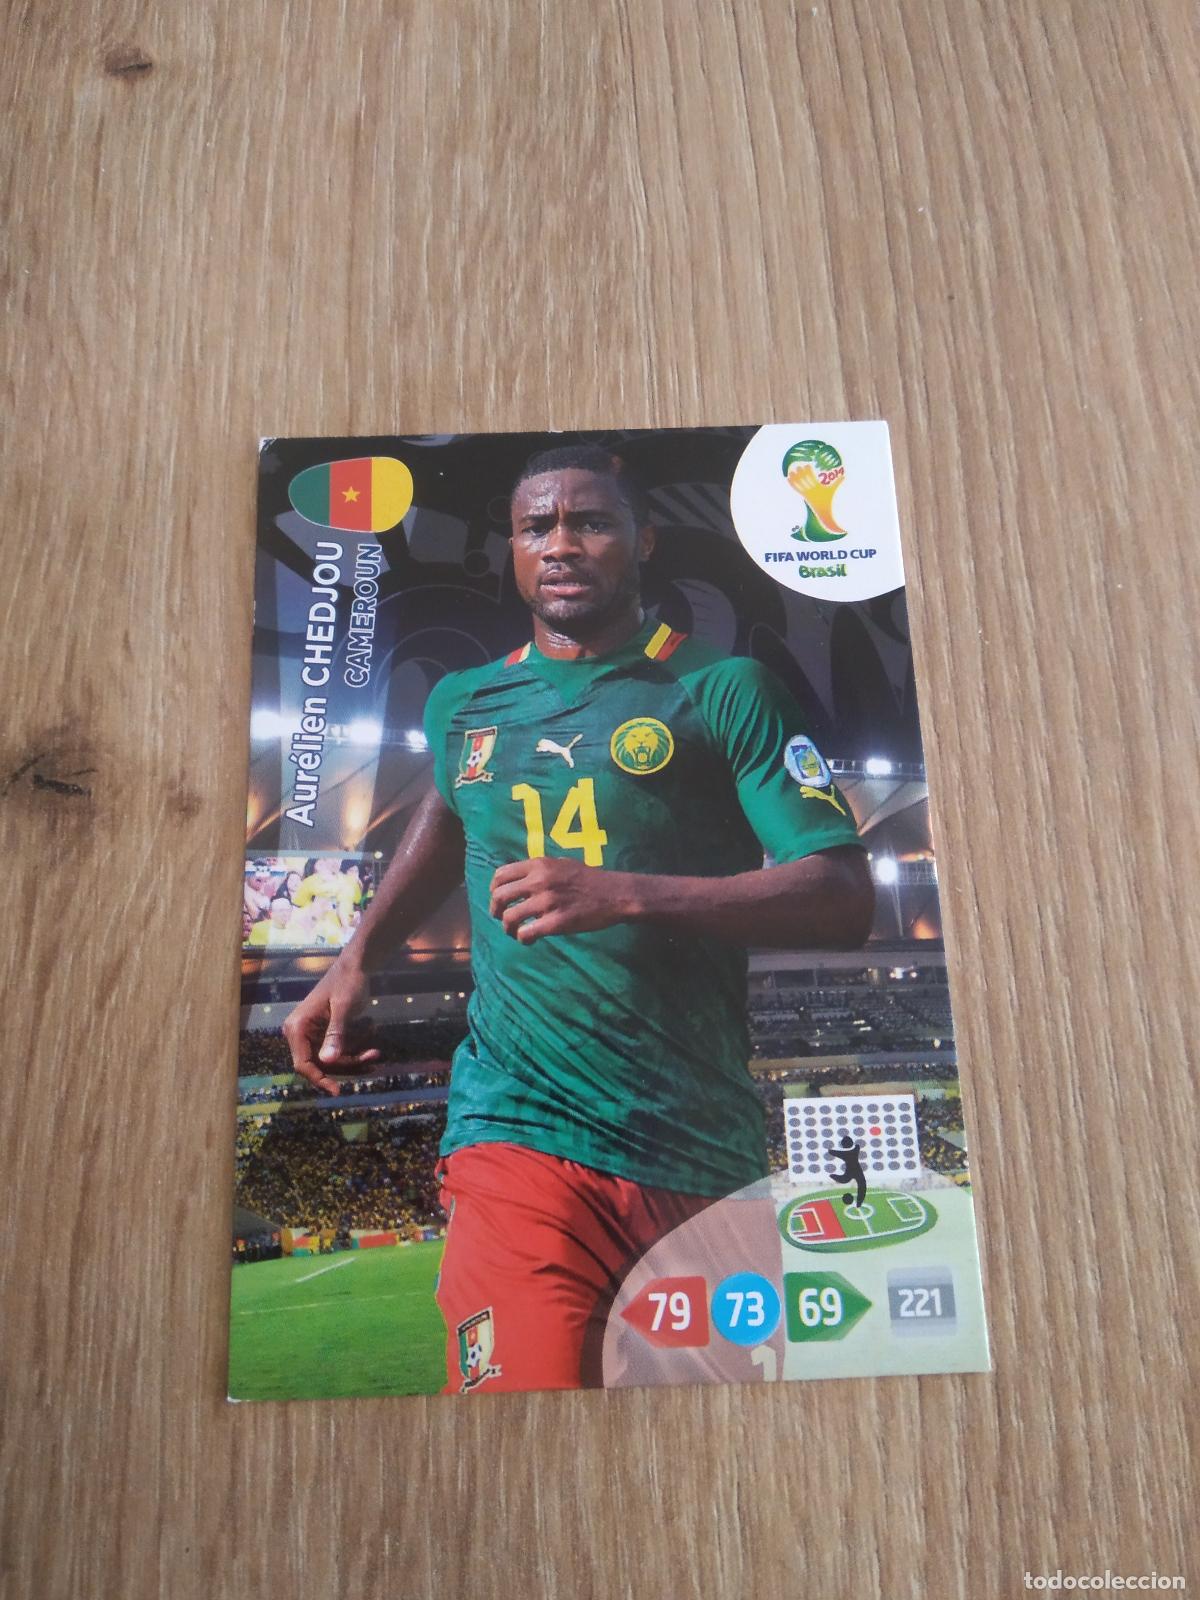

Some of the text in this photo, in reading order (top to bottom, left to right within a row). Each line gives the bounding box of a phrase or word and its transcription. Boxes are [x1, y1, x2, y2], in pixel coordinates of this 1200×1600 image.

[764, 548, 877, 562] FIFA WORLD CUP
[798, 563, 847, 578] Brasil
[344, 543, 383, 688] CAMEROUN
[285, 541, 344, 828] Aurélien CHEDJOU
[511, 778, 608, 868] 14
[648, 1292, 691, 1331] 79
[725, 1291, 766, 1328] 73
[799, 1287, 843, 1327] 69
[898, 1288, 943, 1317] 221
